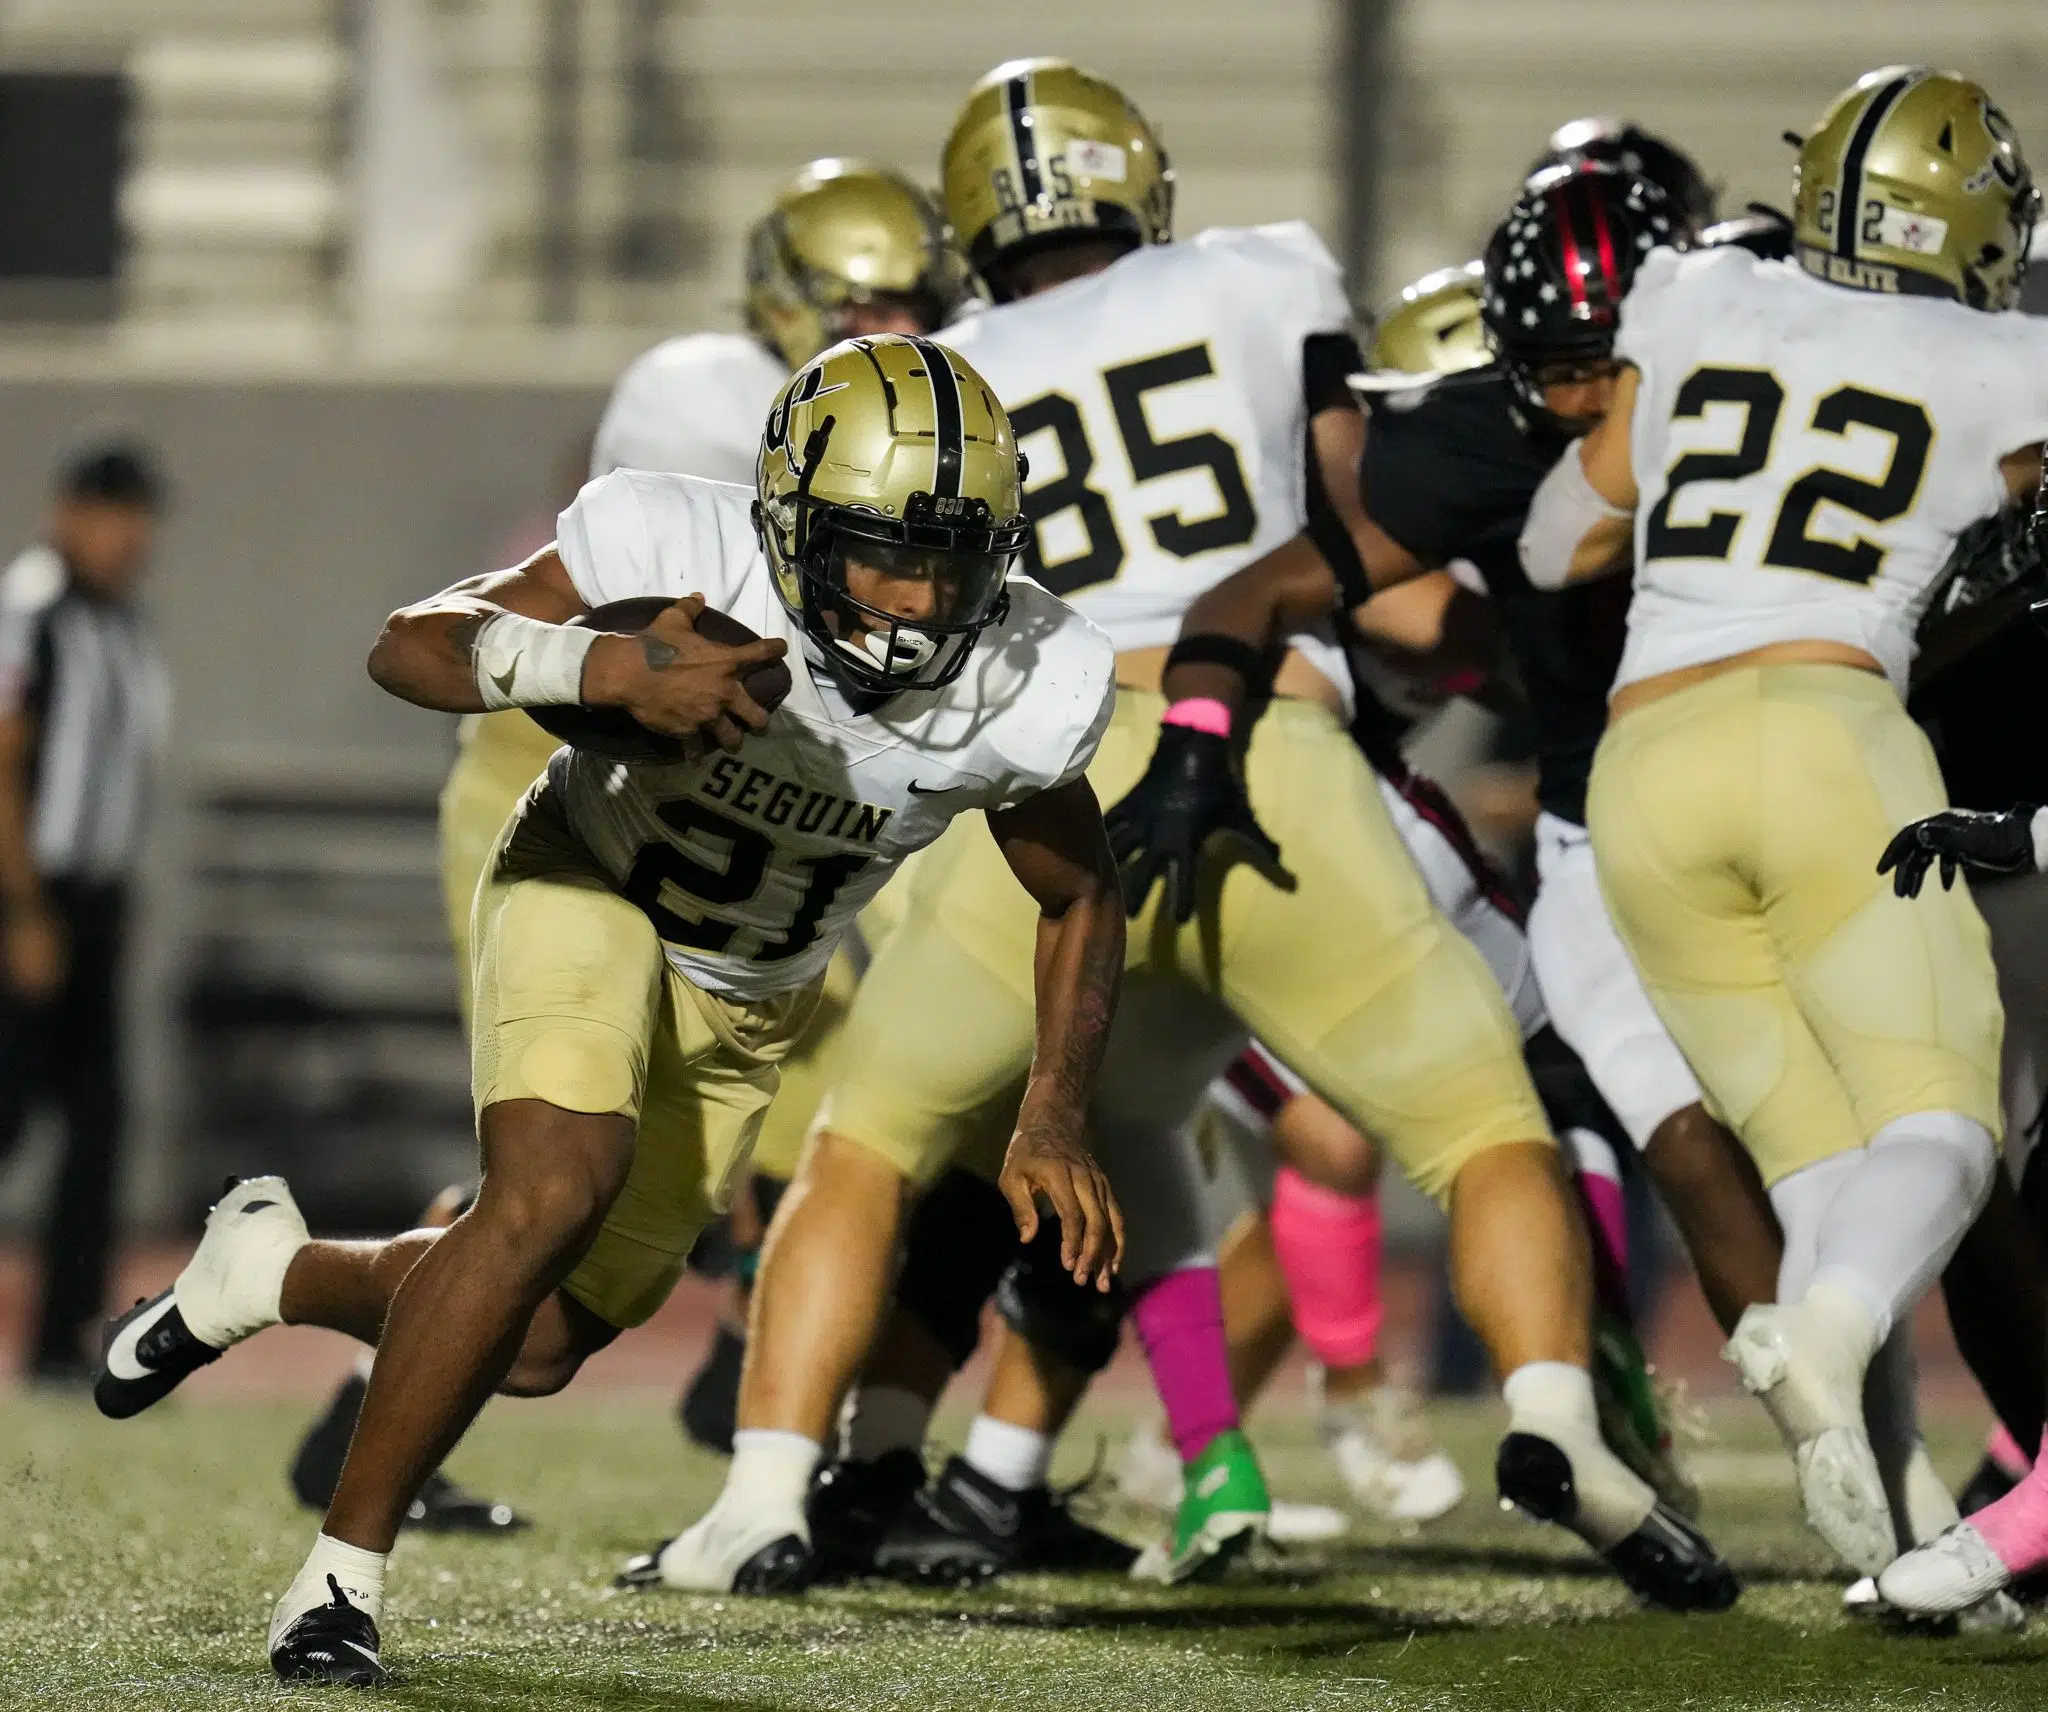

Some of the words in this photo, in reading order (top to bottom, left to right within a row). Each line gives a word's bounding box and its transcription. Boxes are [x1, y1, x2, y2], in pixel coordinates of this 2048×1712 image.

[934, 497, 965, 516] 830
[1006, 340, 1257, 597] 85
[1645, 364, 1938, 586] 22
[624, 798, 874, 961] 21
[702, 757, 895, 843] SEGUIN
